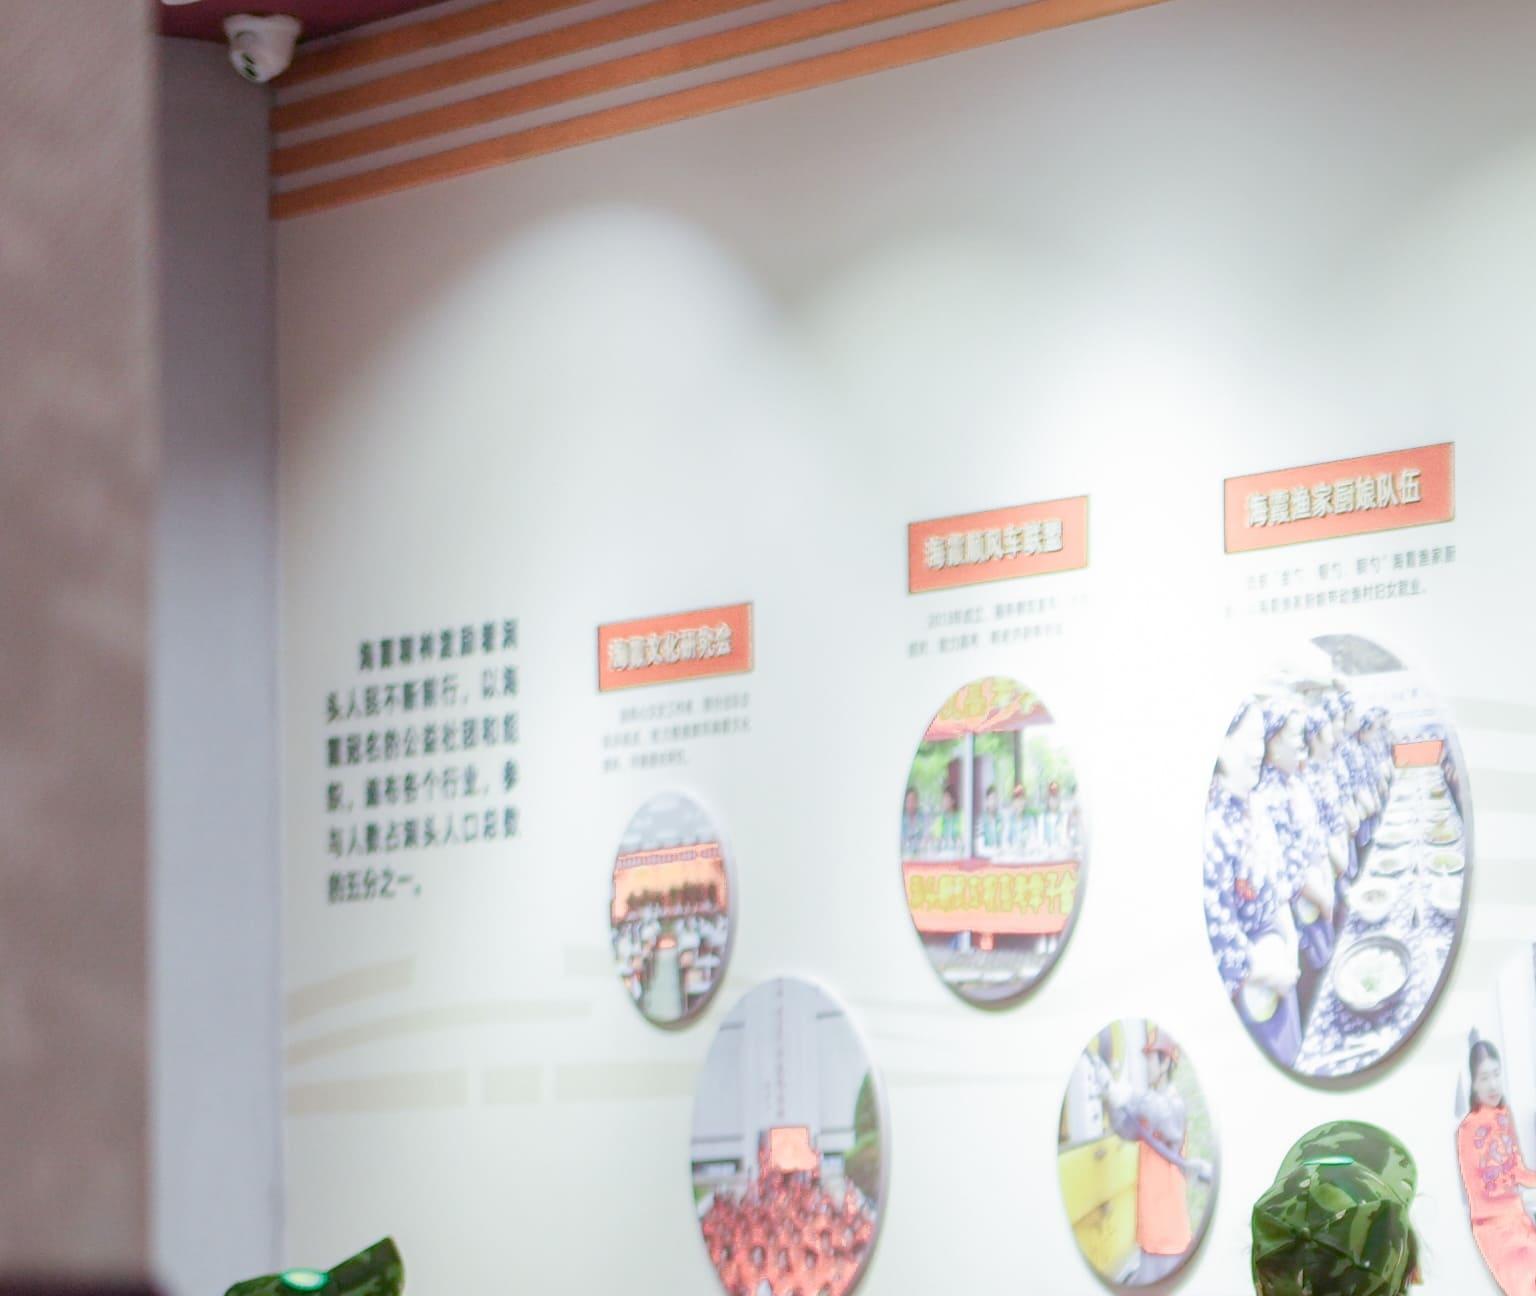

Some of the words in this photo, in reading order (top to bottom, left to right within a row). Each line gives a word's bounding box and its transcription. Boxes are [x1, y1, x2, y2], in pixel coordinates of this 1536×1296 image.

[1247, 469, 1422, 528] 海霞渔家厨娘队伍
